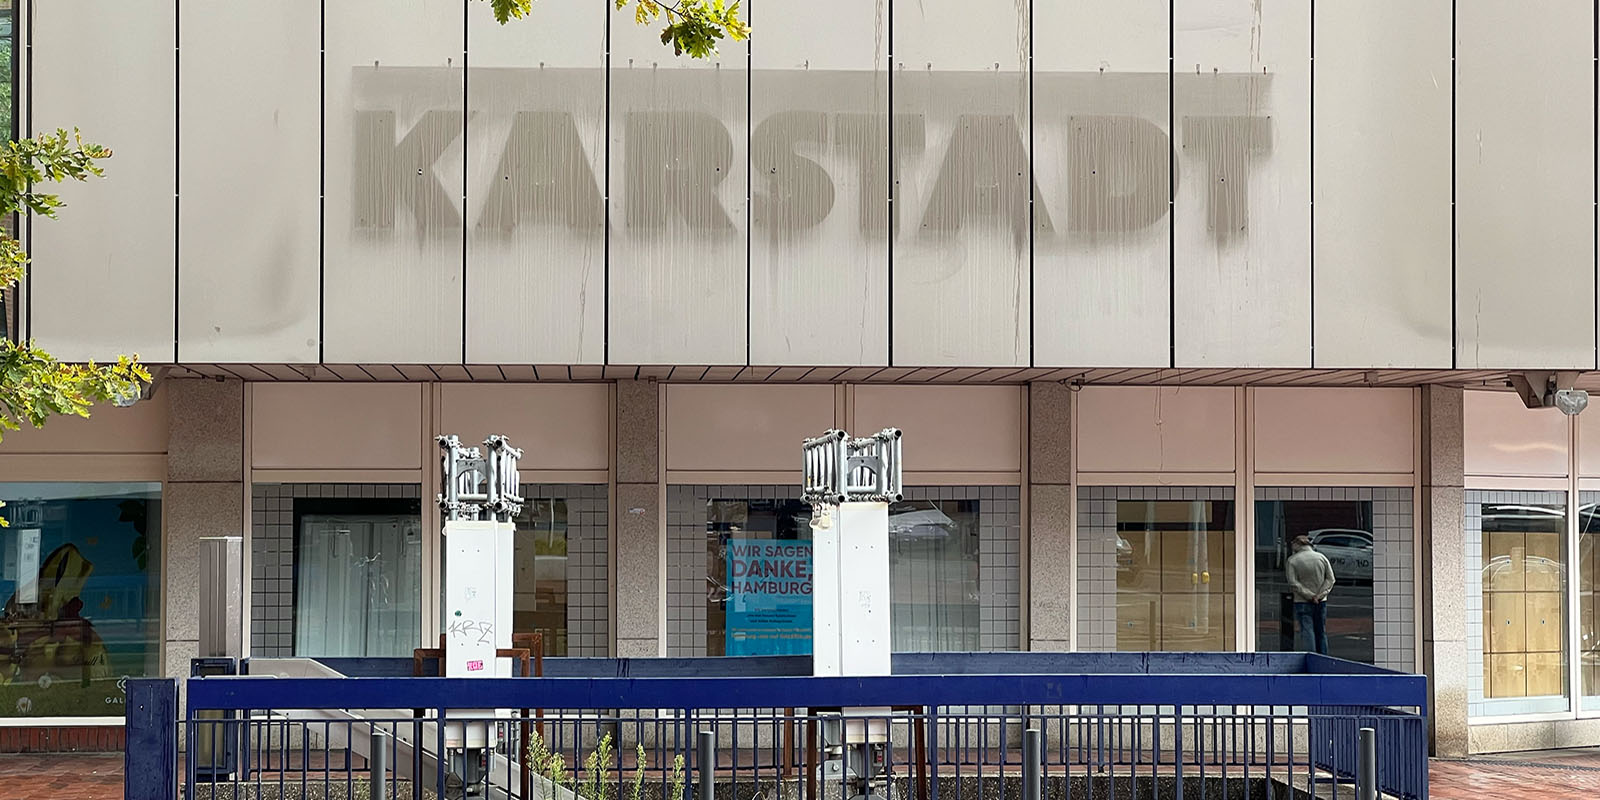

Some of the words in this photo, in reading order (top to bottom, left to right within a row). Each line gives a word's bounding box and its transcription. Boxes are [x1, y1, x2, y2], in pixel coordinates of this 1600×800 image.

[354, 110, 1273, 234] KARSTADT
[732, 545, 760, 557] WIR
[765, 545, 812, 558] SAGEN
[731, 560, 812, 581] DANKE,
[731, 581, 812, 595] HAMBURG
